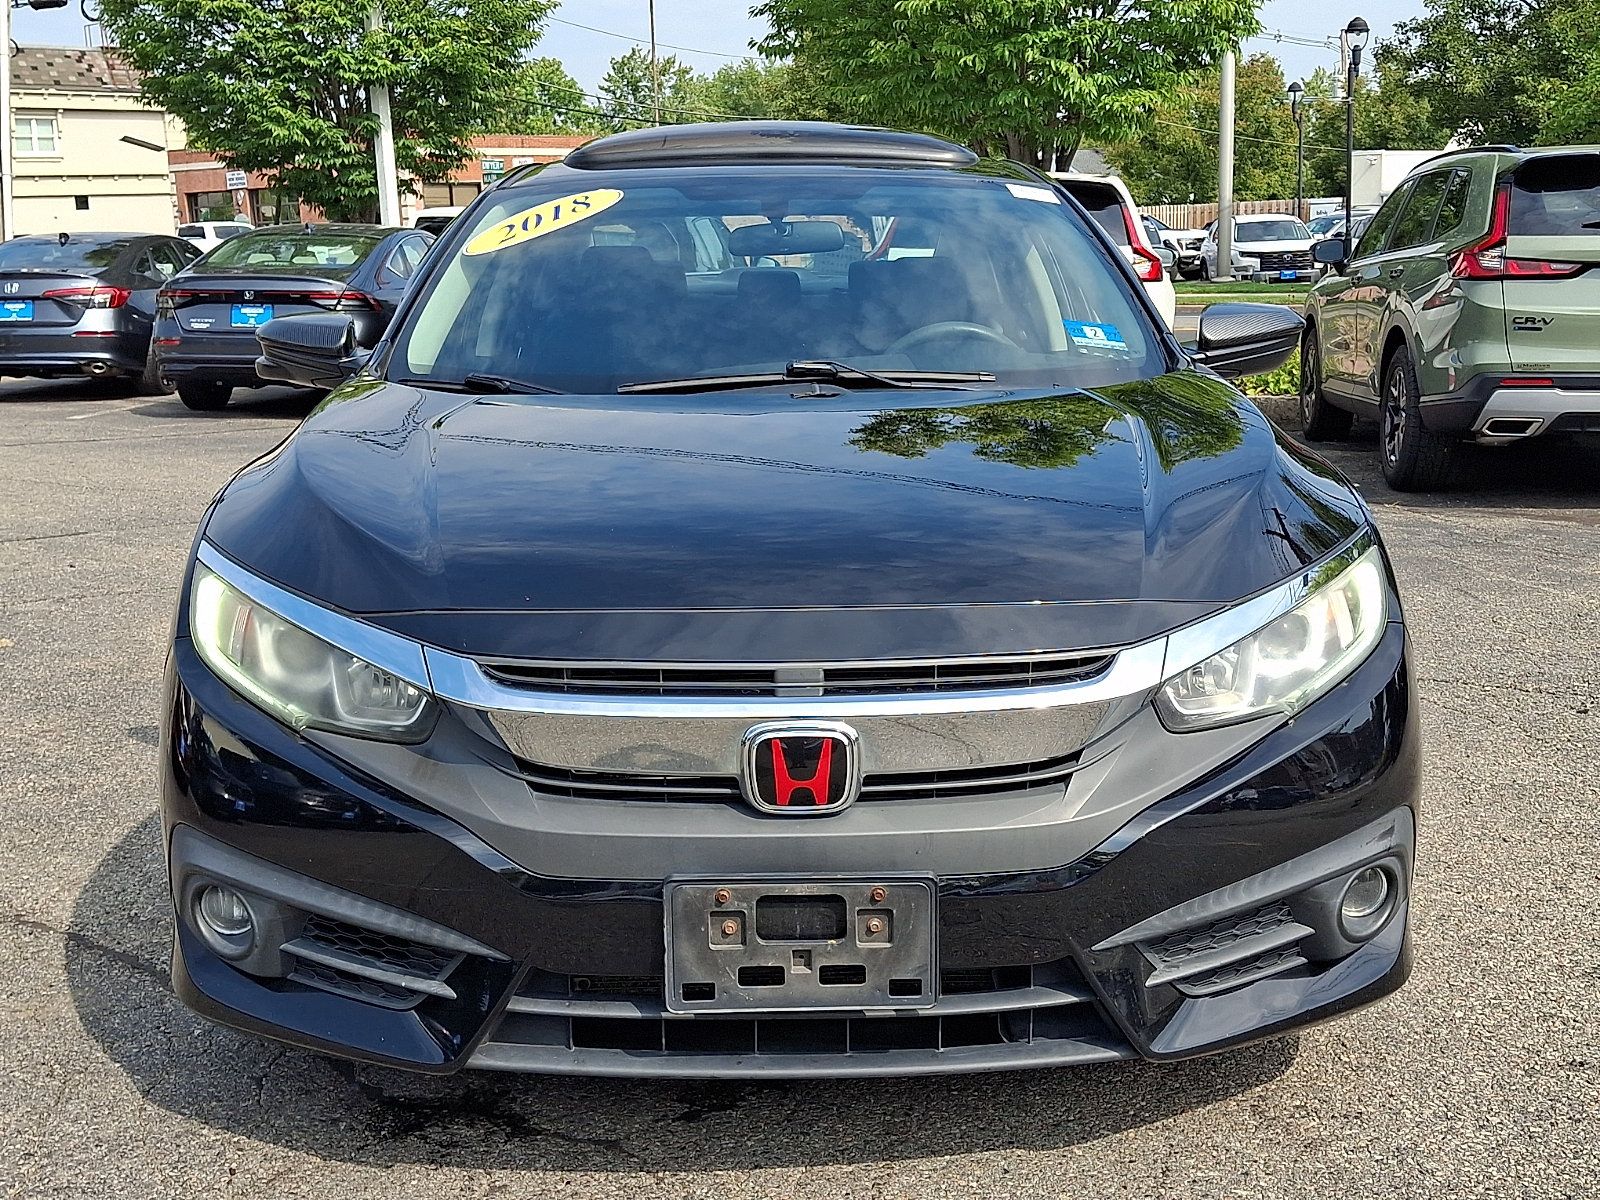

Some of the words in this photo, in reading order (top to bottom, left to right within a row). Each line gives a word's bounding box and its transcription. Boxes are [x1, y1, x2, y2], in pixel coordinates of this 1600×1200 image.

[497, 195, 591, 245] 2018
[1512, 316, 1555, 326] CR-V
[1090, 328, 1100, 338] 2
